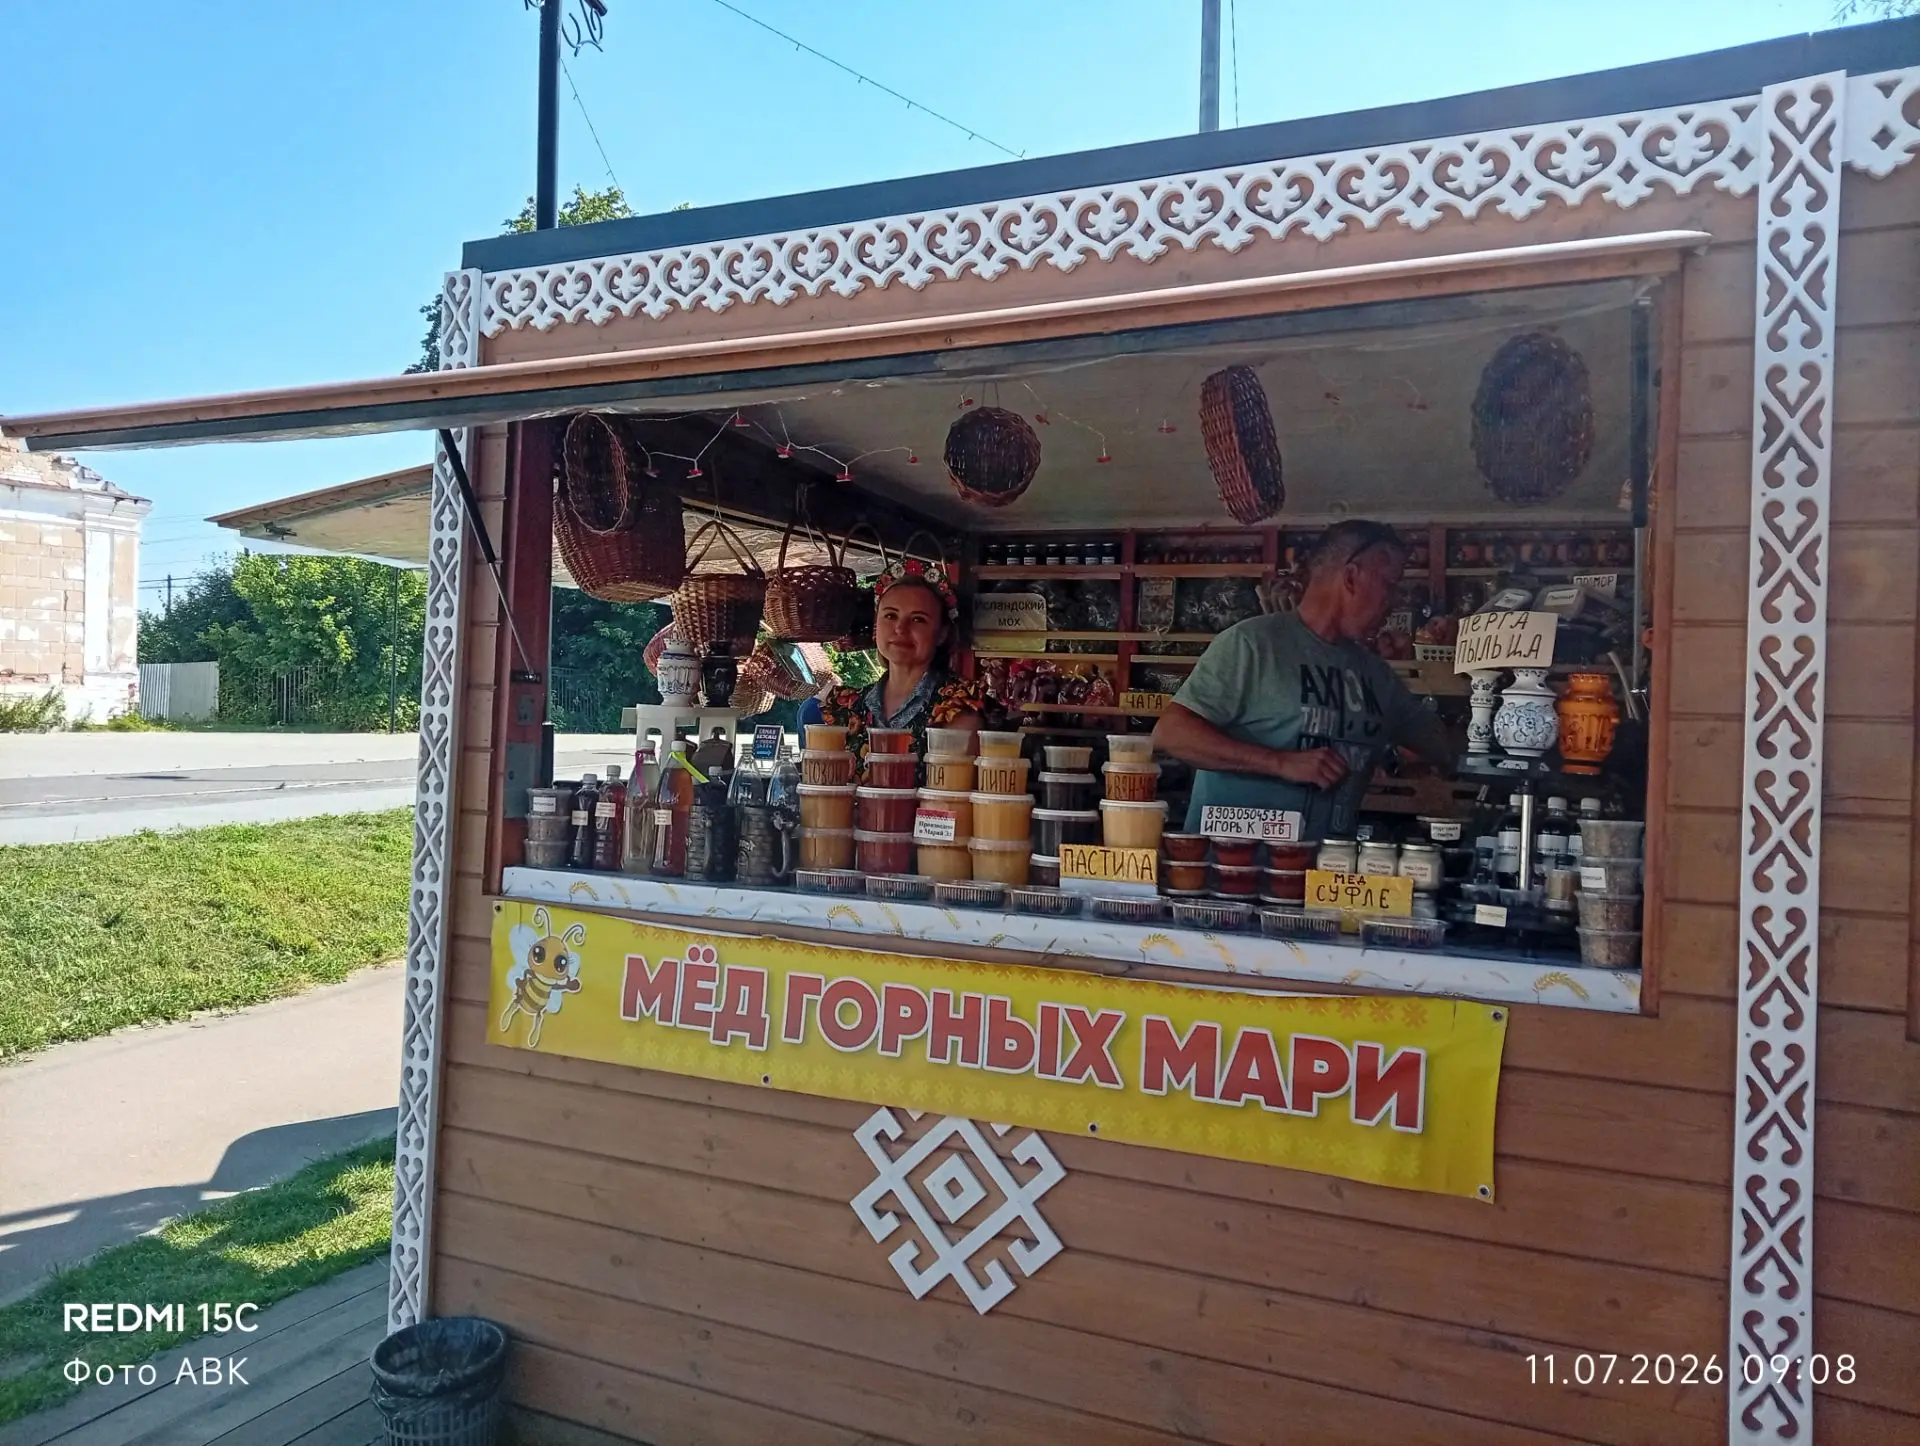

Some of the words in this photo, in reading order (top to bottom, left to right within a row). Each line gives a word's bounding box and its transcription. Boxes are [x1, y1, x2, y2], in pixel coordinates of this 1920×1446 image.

[998, 617, 1021, 627] мох
[1457, 634, 1542, 664] ПЫЛЬЦА
[1126, 693, 1163, 709] ЧАГА
[980, 768, 1017, 793] ЛИПА
[1204, 820, 1243, 833] ИГОРЬ
[1064, 848, 1153, 880] ПАСТИЛА
[1334, 873, 1367, 885] МЕД
[1316, 884, 1390, 909] СУФЛЕ
[620, 944, 771, 1051] МЁД
[781, 972, 1127, 1090] ГОРНЫХ
[1139, 1014, 1427, 1134] МАРИ
